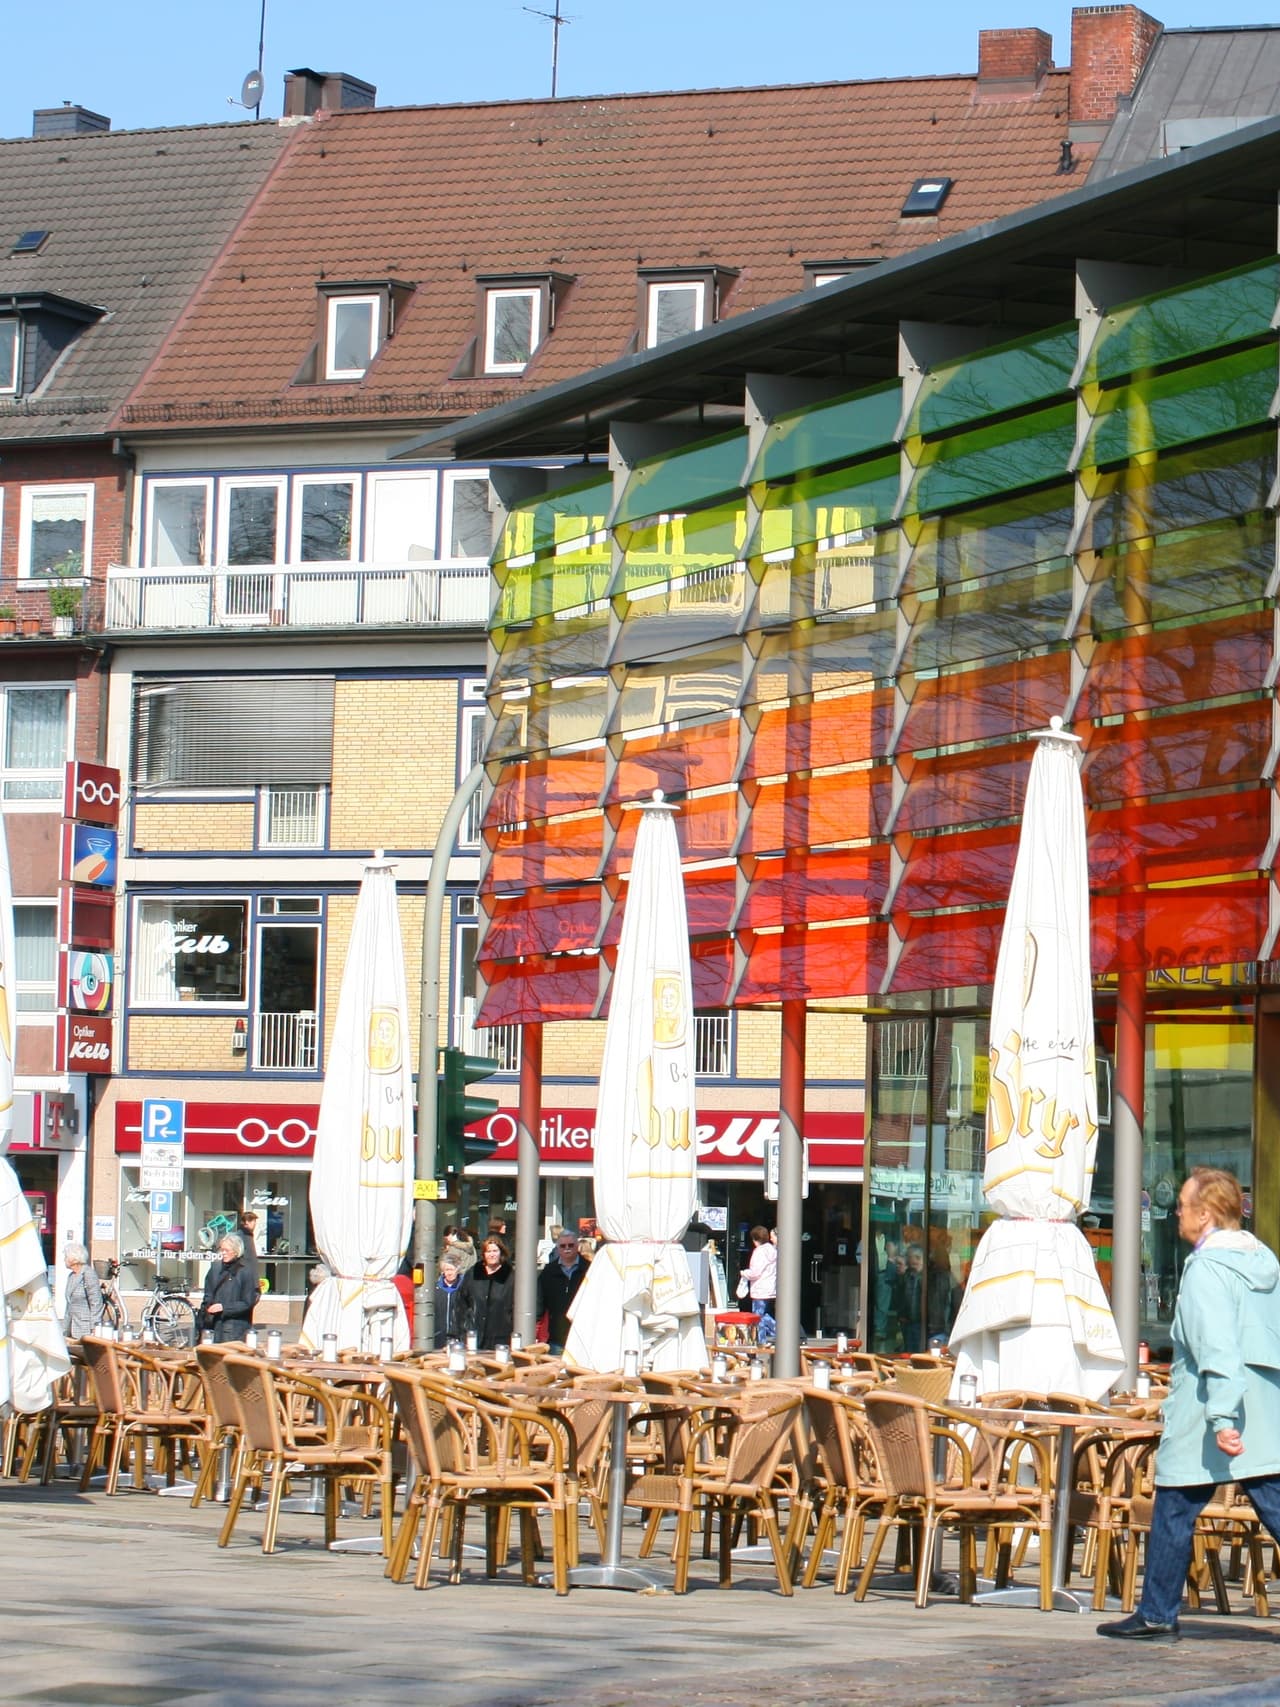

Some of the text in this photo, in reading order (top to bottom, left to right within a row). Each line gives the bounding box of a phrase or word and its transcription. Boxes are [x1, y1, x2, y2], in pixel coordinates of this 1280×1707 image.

[73, 1025, 96, 1040] Optiker
[69, 1041, 110, 1061] Kelb
[148, 1104, 172, 1138] P
[416, 1184, 434, 1192] AXI
[155, 1194, 167, 1210] P
[251, 1196, 289, 1207] Kelb
[178, 1250, 204, 1262] jeden
[206, 1252, 223, 1262] Spo
